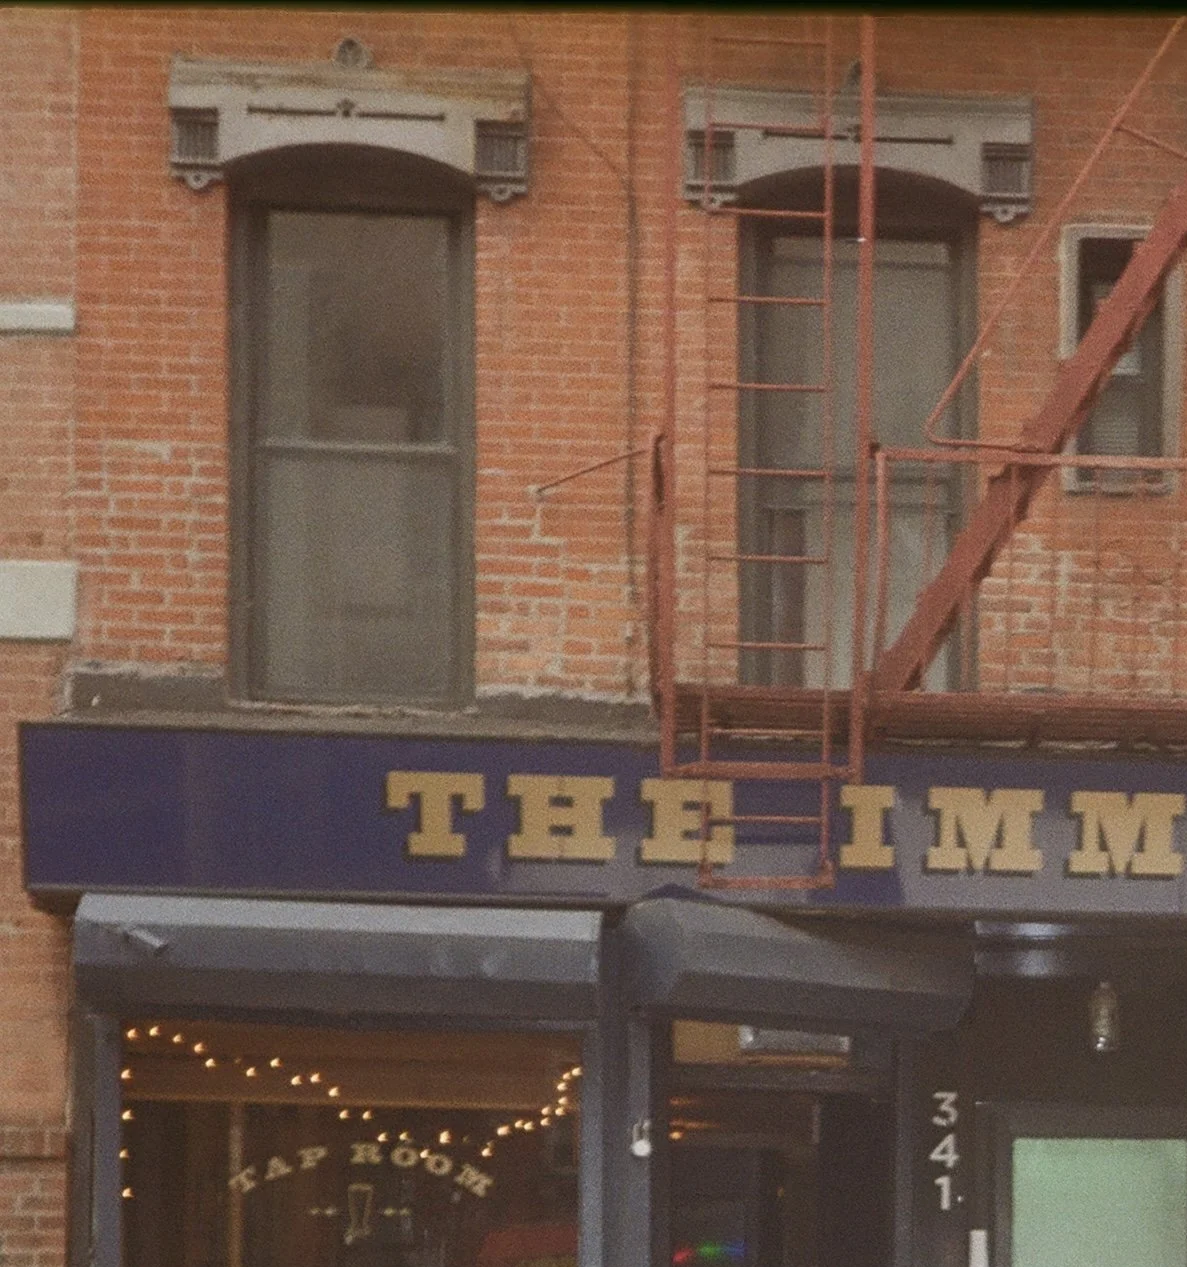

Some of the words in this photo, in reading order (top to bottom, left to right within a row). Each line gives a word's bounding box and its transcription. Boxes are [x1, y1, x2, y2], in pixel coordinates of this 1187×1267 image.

[385, 771, 735, 865] THE
[228, 1145, 328, 1193] TAP
[349, 1142, 494, 1197] ROOM
[929, 1091, 959, 1211] 341
